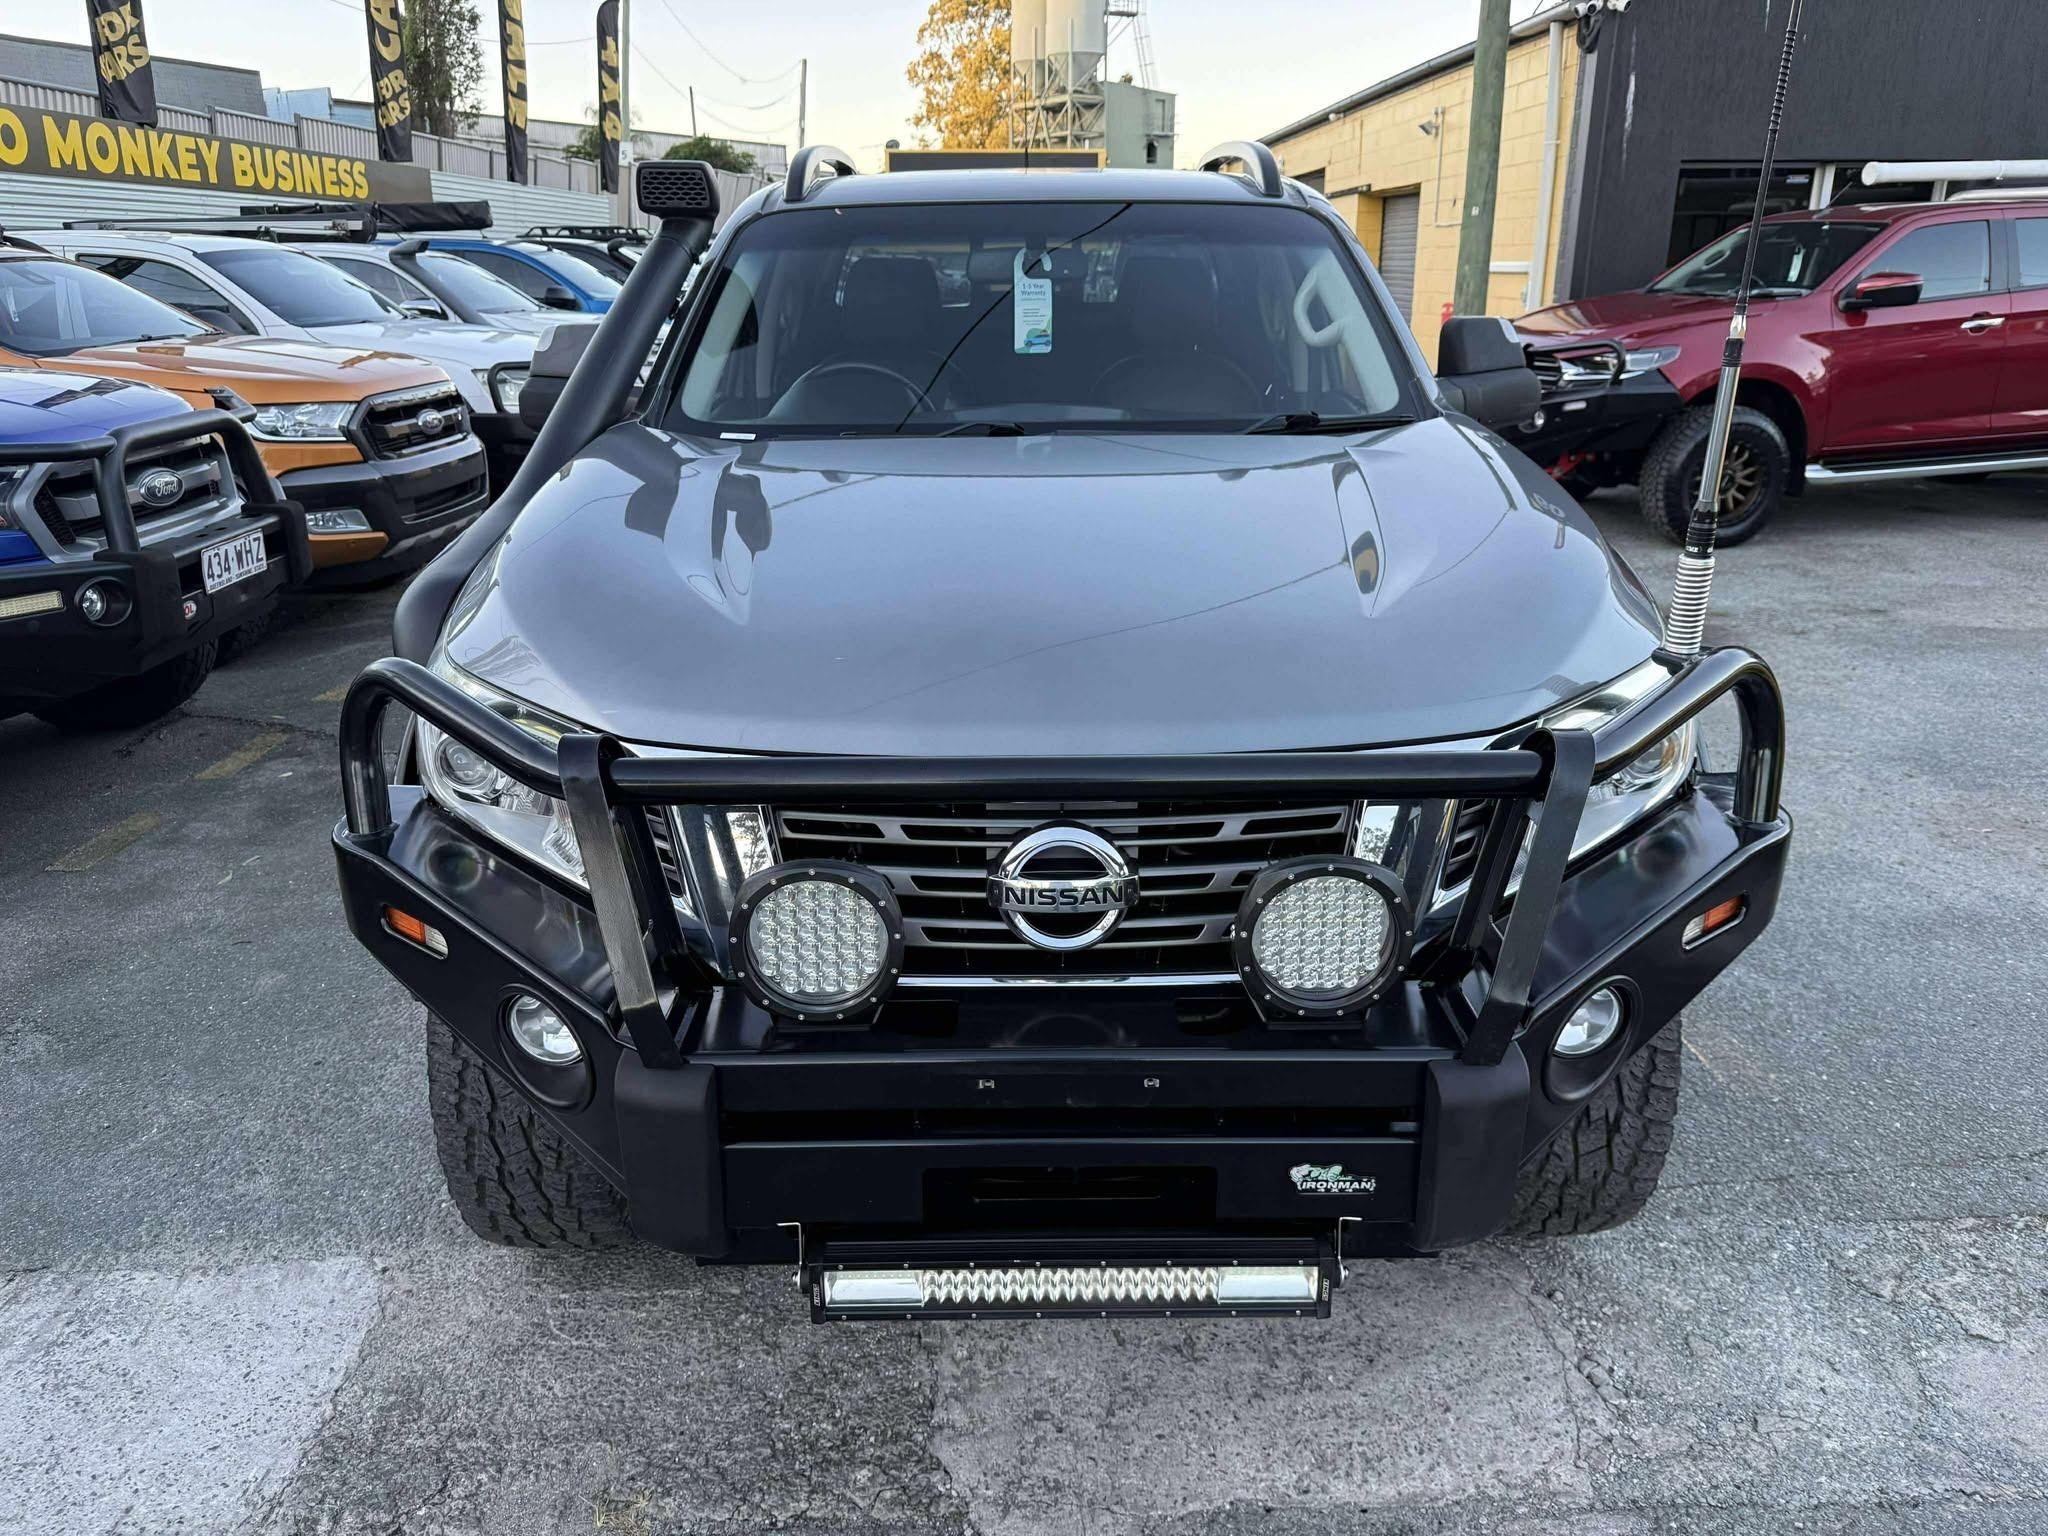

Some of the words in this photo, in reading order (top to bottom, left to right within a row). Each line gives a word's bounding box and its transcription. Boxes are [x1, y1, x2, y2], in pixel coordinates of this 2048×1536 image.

[42, 115, 220, 184] MONKEY
[231, 143, 369, 199] BUSINESS
[1021, 290, 1046, 298] Warranty
[154, 476, 179, 497] Ford
[1004, 885, 1123, 906] NISSAN
[1301, 1181, 1371, 1190] IRONMAN
